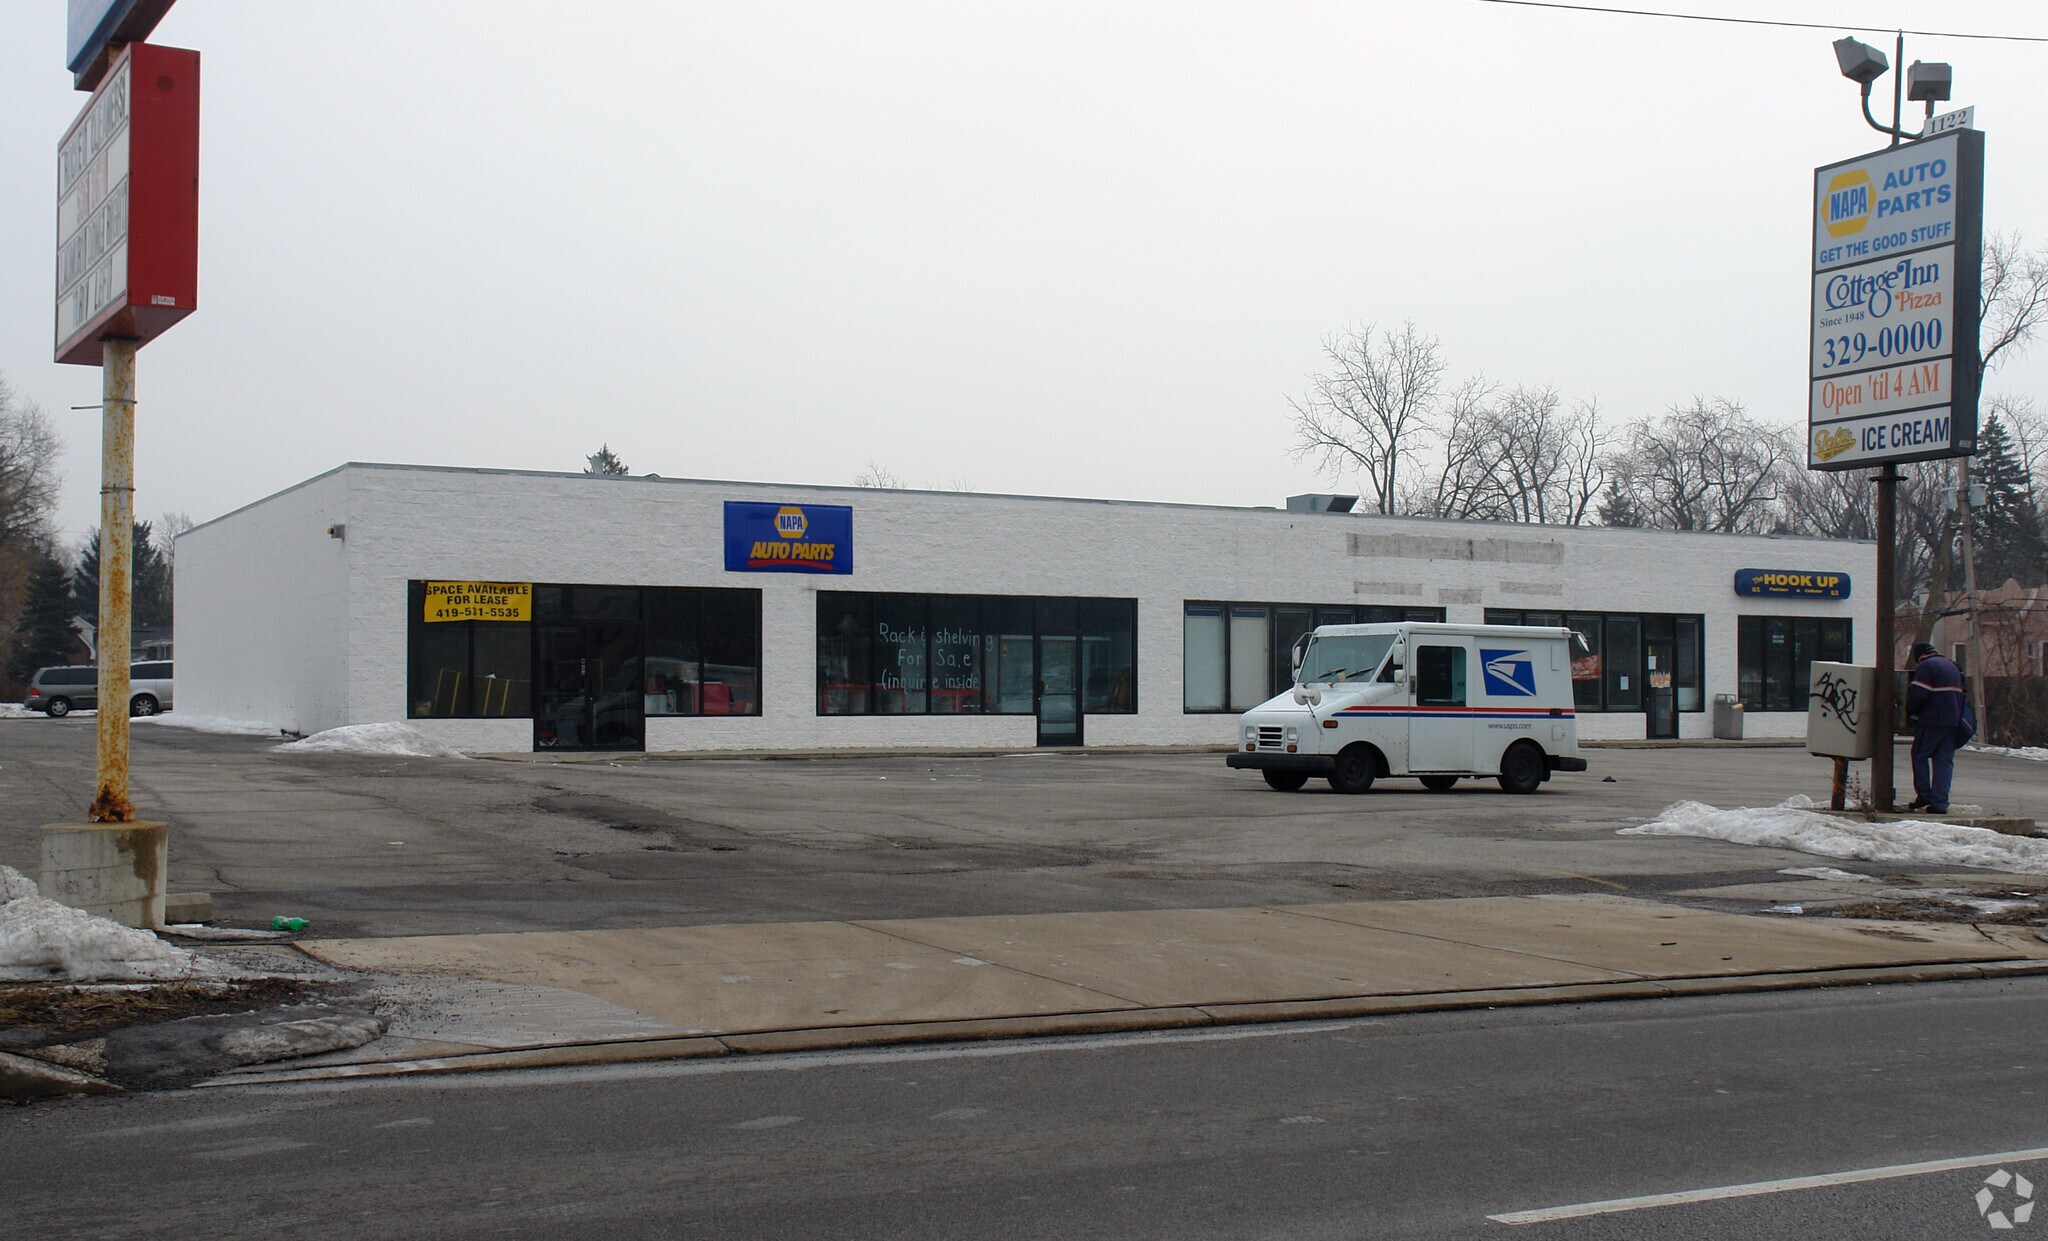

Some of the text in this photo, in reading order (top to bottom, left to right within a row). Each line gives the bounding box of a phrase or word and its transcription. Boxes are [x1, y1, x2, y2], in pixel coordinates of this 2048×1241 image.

[1929, 110, 1968, 134] 1122
[1883, 159, 1946, 191] AUTO
[1830, 187, 1867, 221] NAPA
[1877, 184, 1951, 218] PARTS
[1820, 221, 1951, 263] GET THE GOOD STUFF
[1825, 258, 1940, 318] Cottage Inn
[1895, 290, 1942, 312] Pizza
[1820, 311, 1865, 328] Since 1948
[1823, 318, 1942, 368] 329-0000
[1822, 363, 1940, 415] Open 'til 4 AM
[1862, 416, 1949, 451] ICE CREAM
[780, 515, 803, 531] NAPA
[749, 541, 835, 560] AUTO PARTS
[426, 585, 529, 595] SPACE AVAILABLE
[1764, 574, 1812, 587] HOOK
[1817, 576, 1839, 587] UP
[447, 595, 508, 605] FOR LEASE
[879, 622, 916, 644] Rack
[898, 649, 923, 666] For
[1488, 723, 1532, 731] www.usps.com
